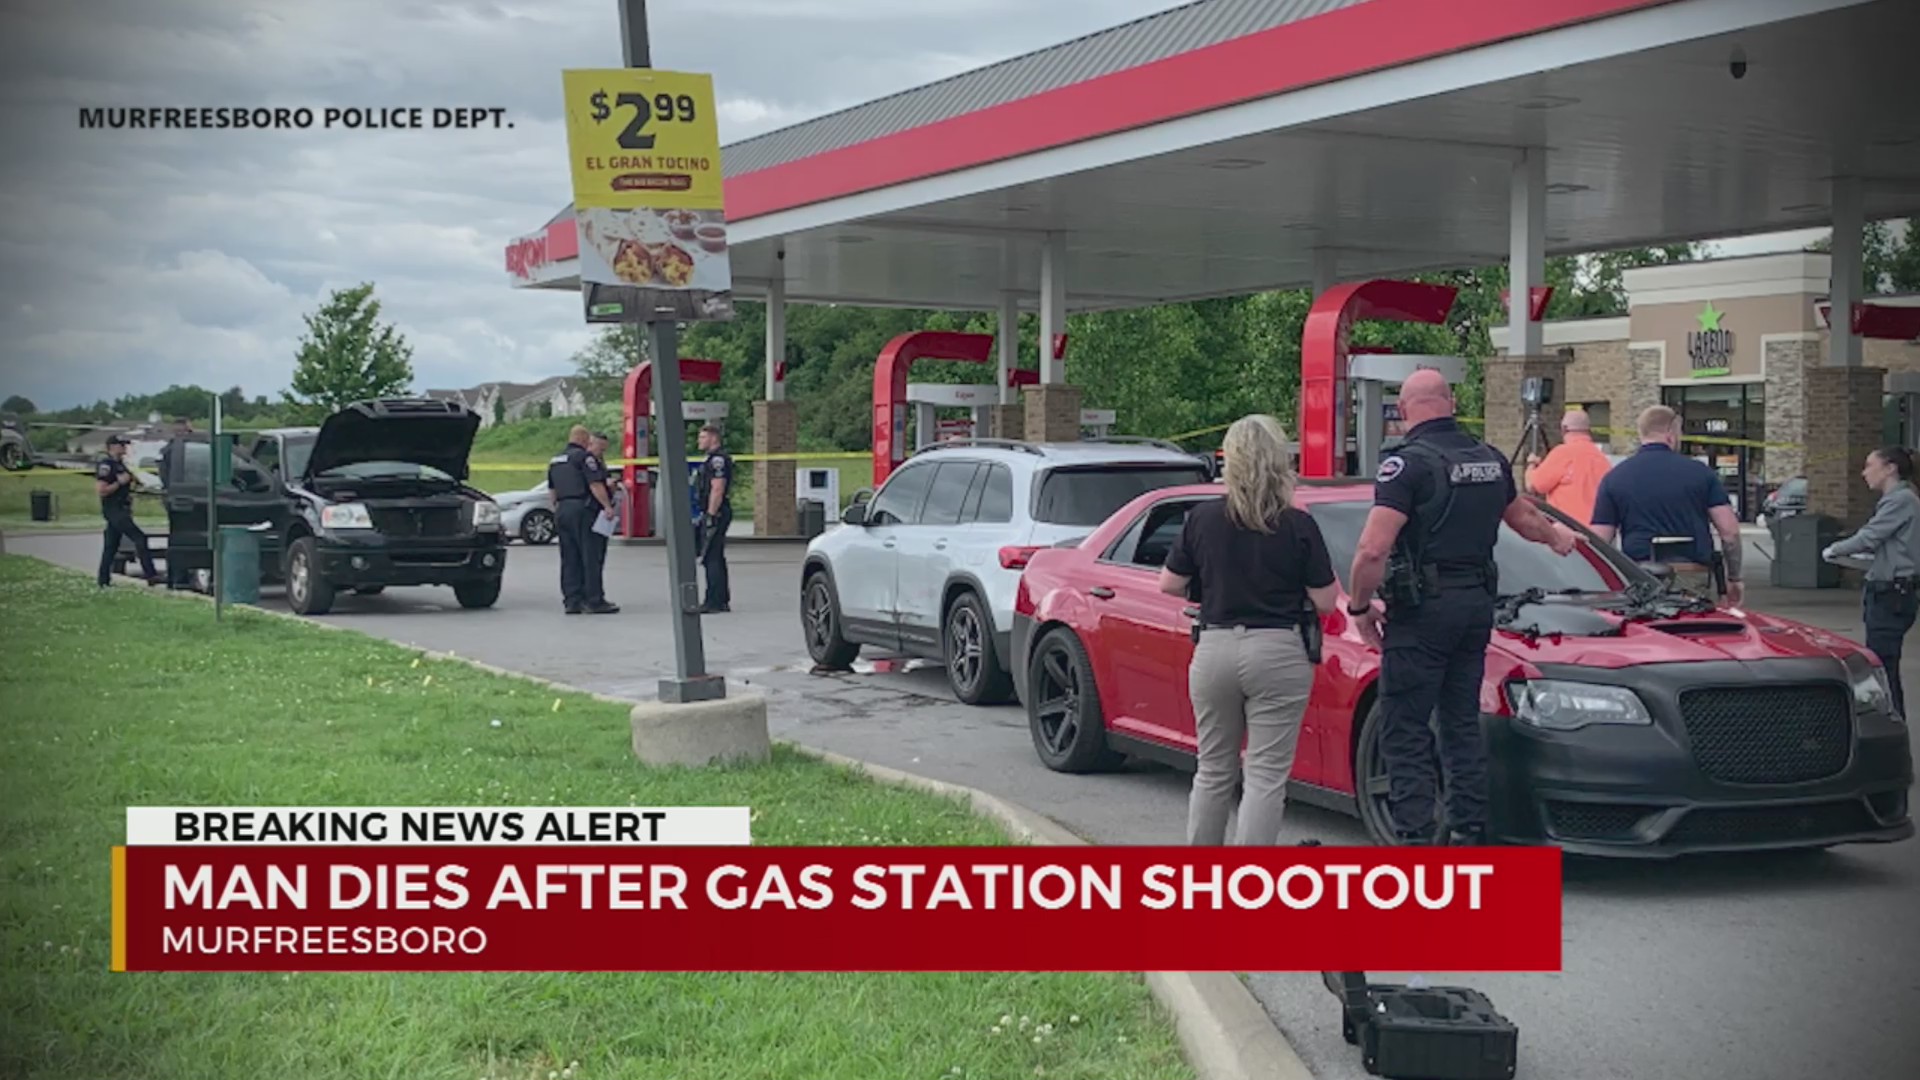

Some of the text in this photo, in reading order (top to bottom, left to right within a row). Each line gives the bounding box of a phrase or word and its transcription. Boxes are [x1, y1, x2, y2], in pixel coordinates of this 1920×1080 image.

[586, 157, 710, 170] EL GRAN TOCINO
